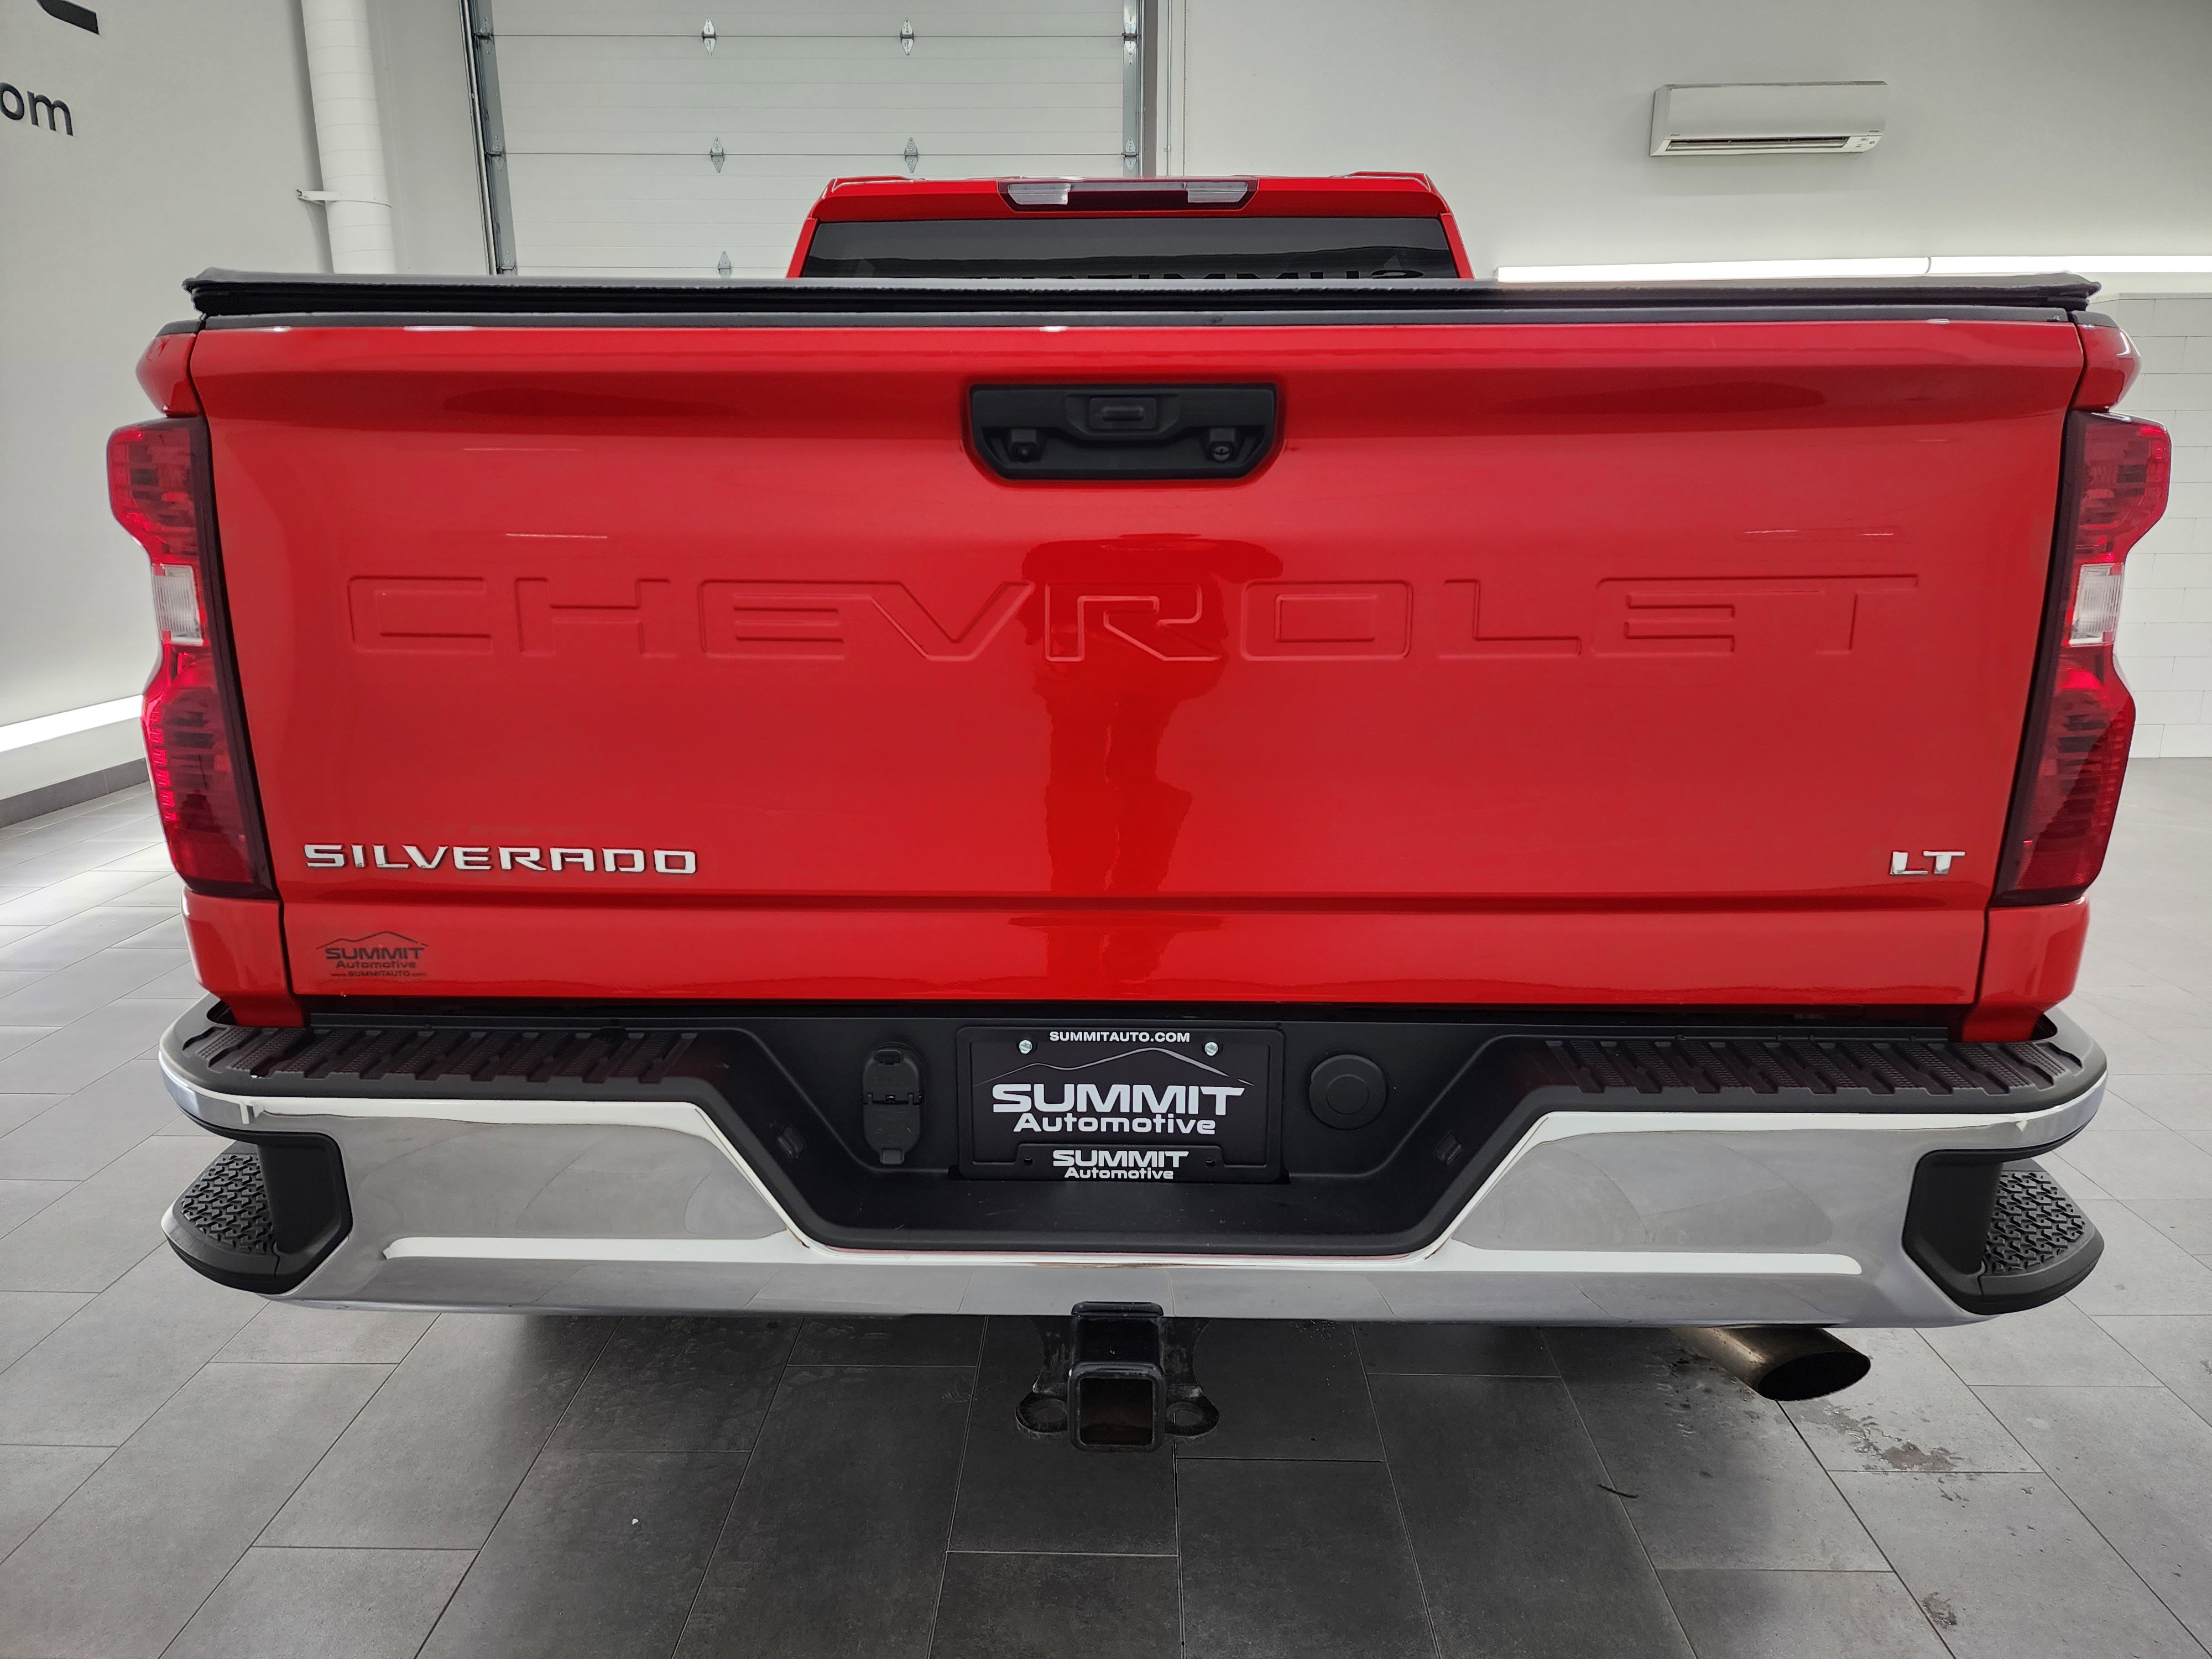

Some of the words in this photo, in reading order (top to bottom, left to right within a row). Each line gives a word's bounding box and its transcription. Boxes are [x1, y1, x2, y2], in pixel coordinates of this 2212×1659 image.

[347, 573, 1919, 662] CHEVROLET
[304, 844, 697, 874] SILVERADO
[1889, 850, 1966, 875] LT
[325, 947, 425, 960] SUMMIT
[336, 960, 416, 968] Automotive
[1049, 1031, 1191, 1043] SUMMITAUTO.COM
[992, 1083, 1245, 1116] SUMMIT
[1013, 1113, 1216, 1135] Automotive
[1052, 1149, 1190, 1168] SUMMIT
[1064, 1167, 1174, 1180] Automotive
